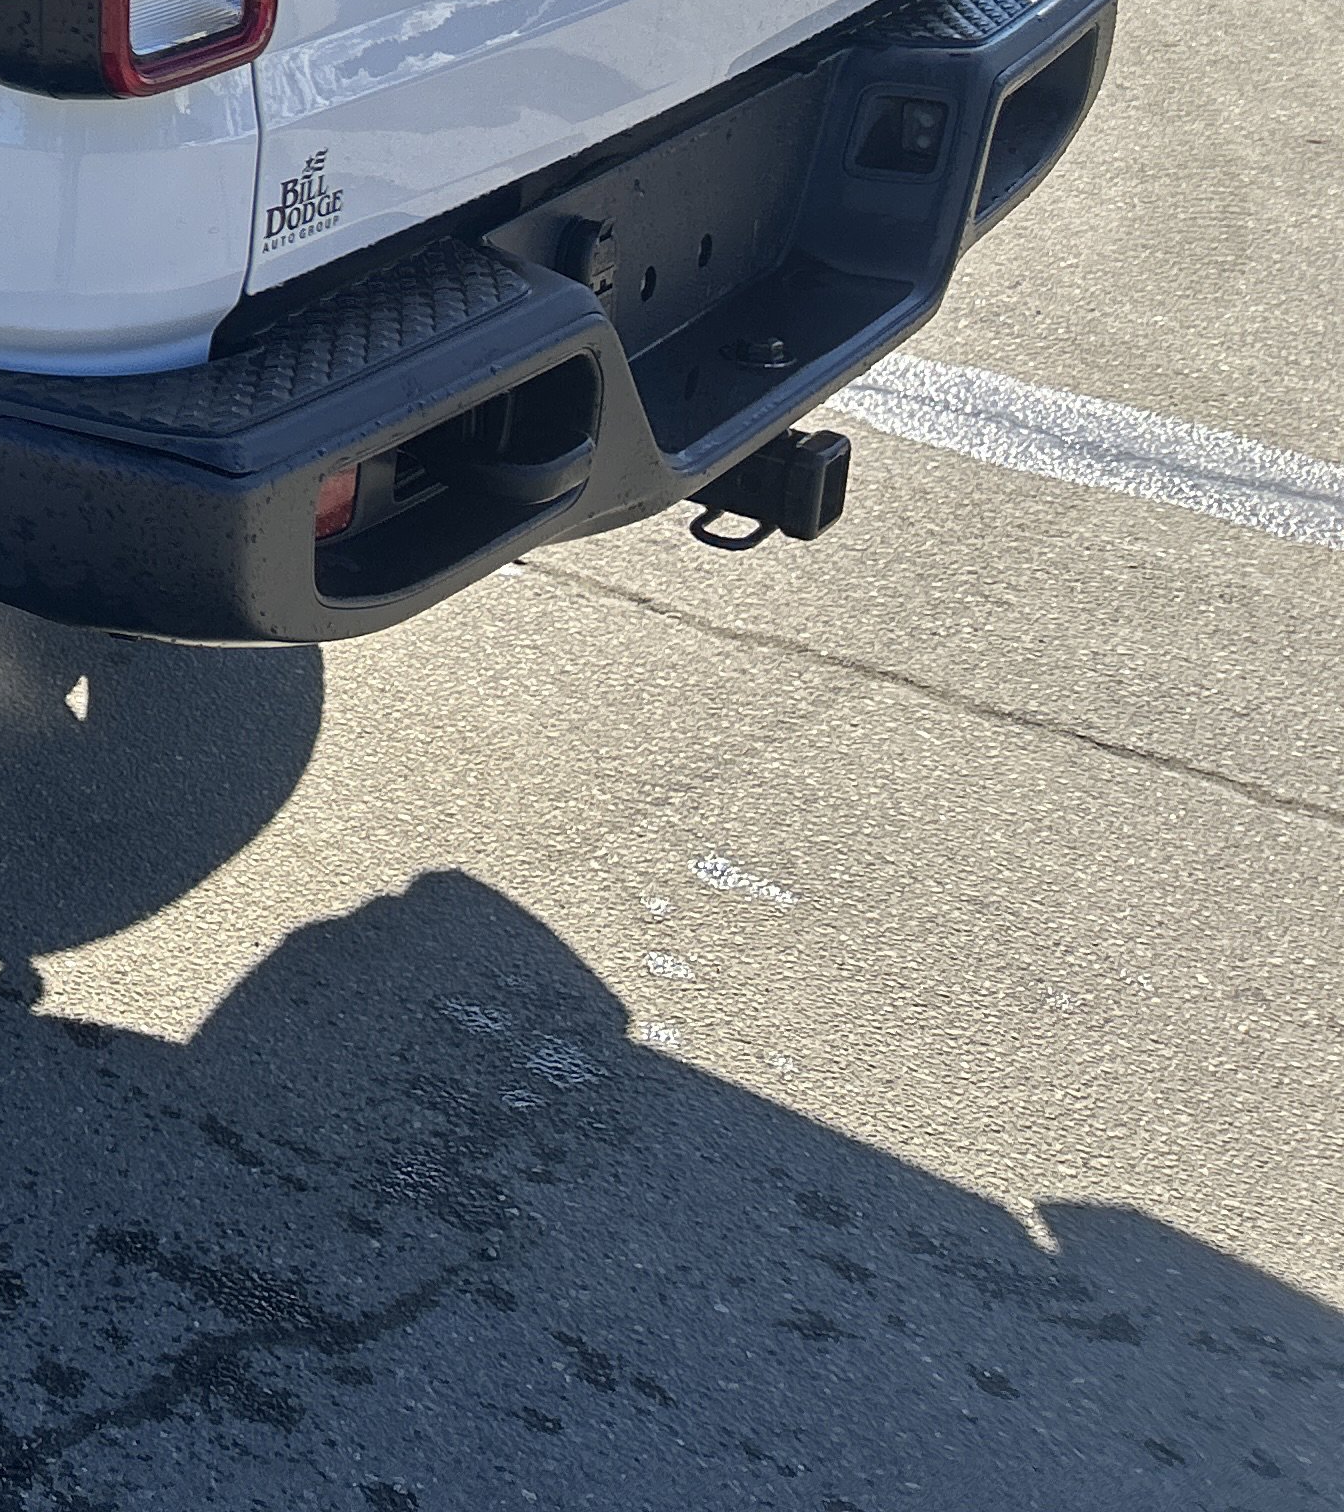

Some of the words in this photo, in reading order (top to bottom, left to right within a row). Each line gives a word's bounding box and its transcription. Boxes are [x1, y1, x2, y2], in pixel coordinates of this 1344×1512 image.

[281, 175, 328, 209] BILL
[264, 190, 343, 238] DODGE
[262, 234, 295, 254] AUTO
[299, 216, 339, 238] GROUP
